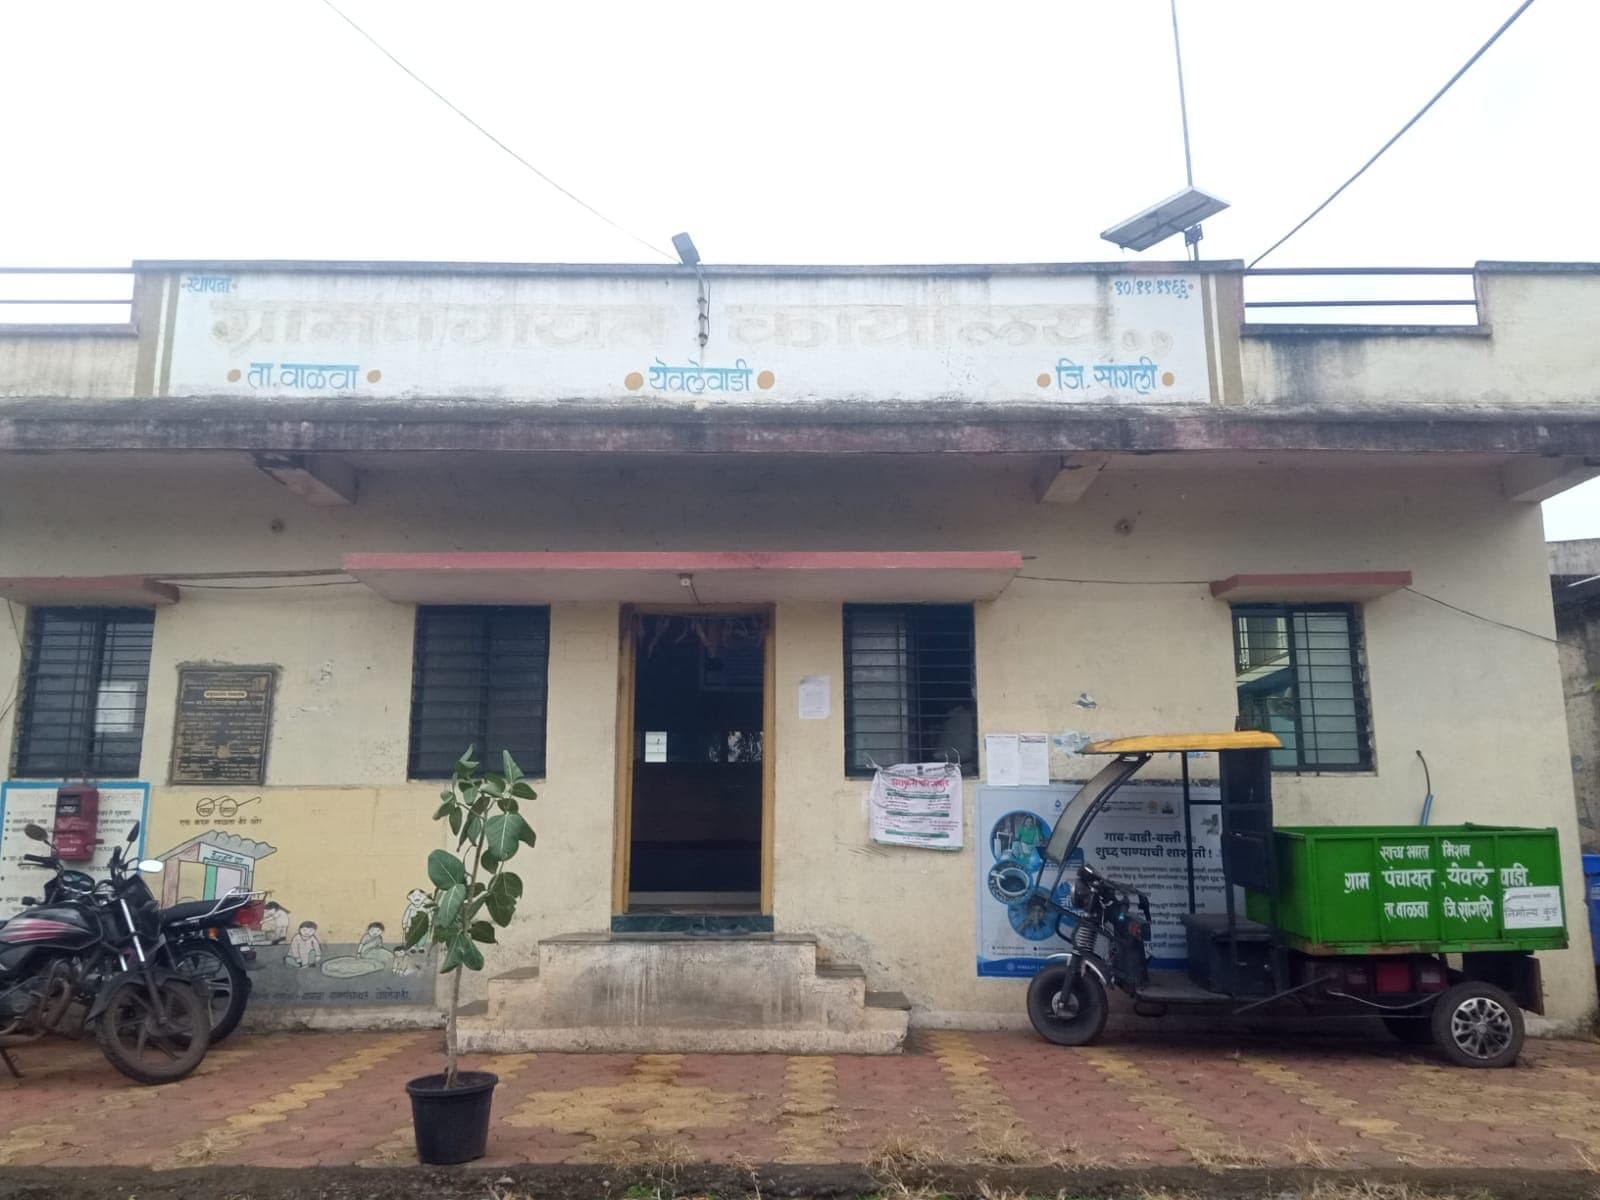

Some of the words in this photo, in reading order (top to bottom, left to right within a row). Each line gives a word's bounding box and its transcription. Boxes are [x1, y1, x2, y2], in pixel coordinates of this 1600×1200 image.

[648, 356, 754, 395] येवलेवाडी
[1442, 840, 1471, 860] मिशन
[1344, 871, 1370, 893] ग्राम
